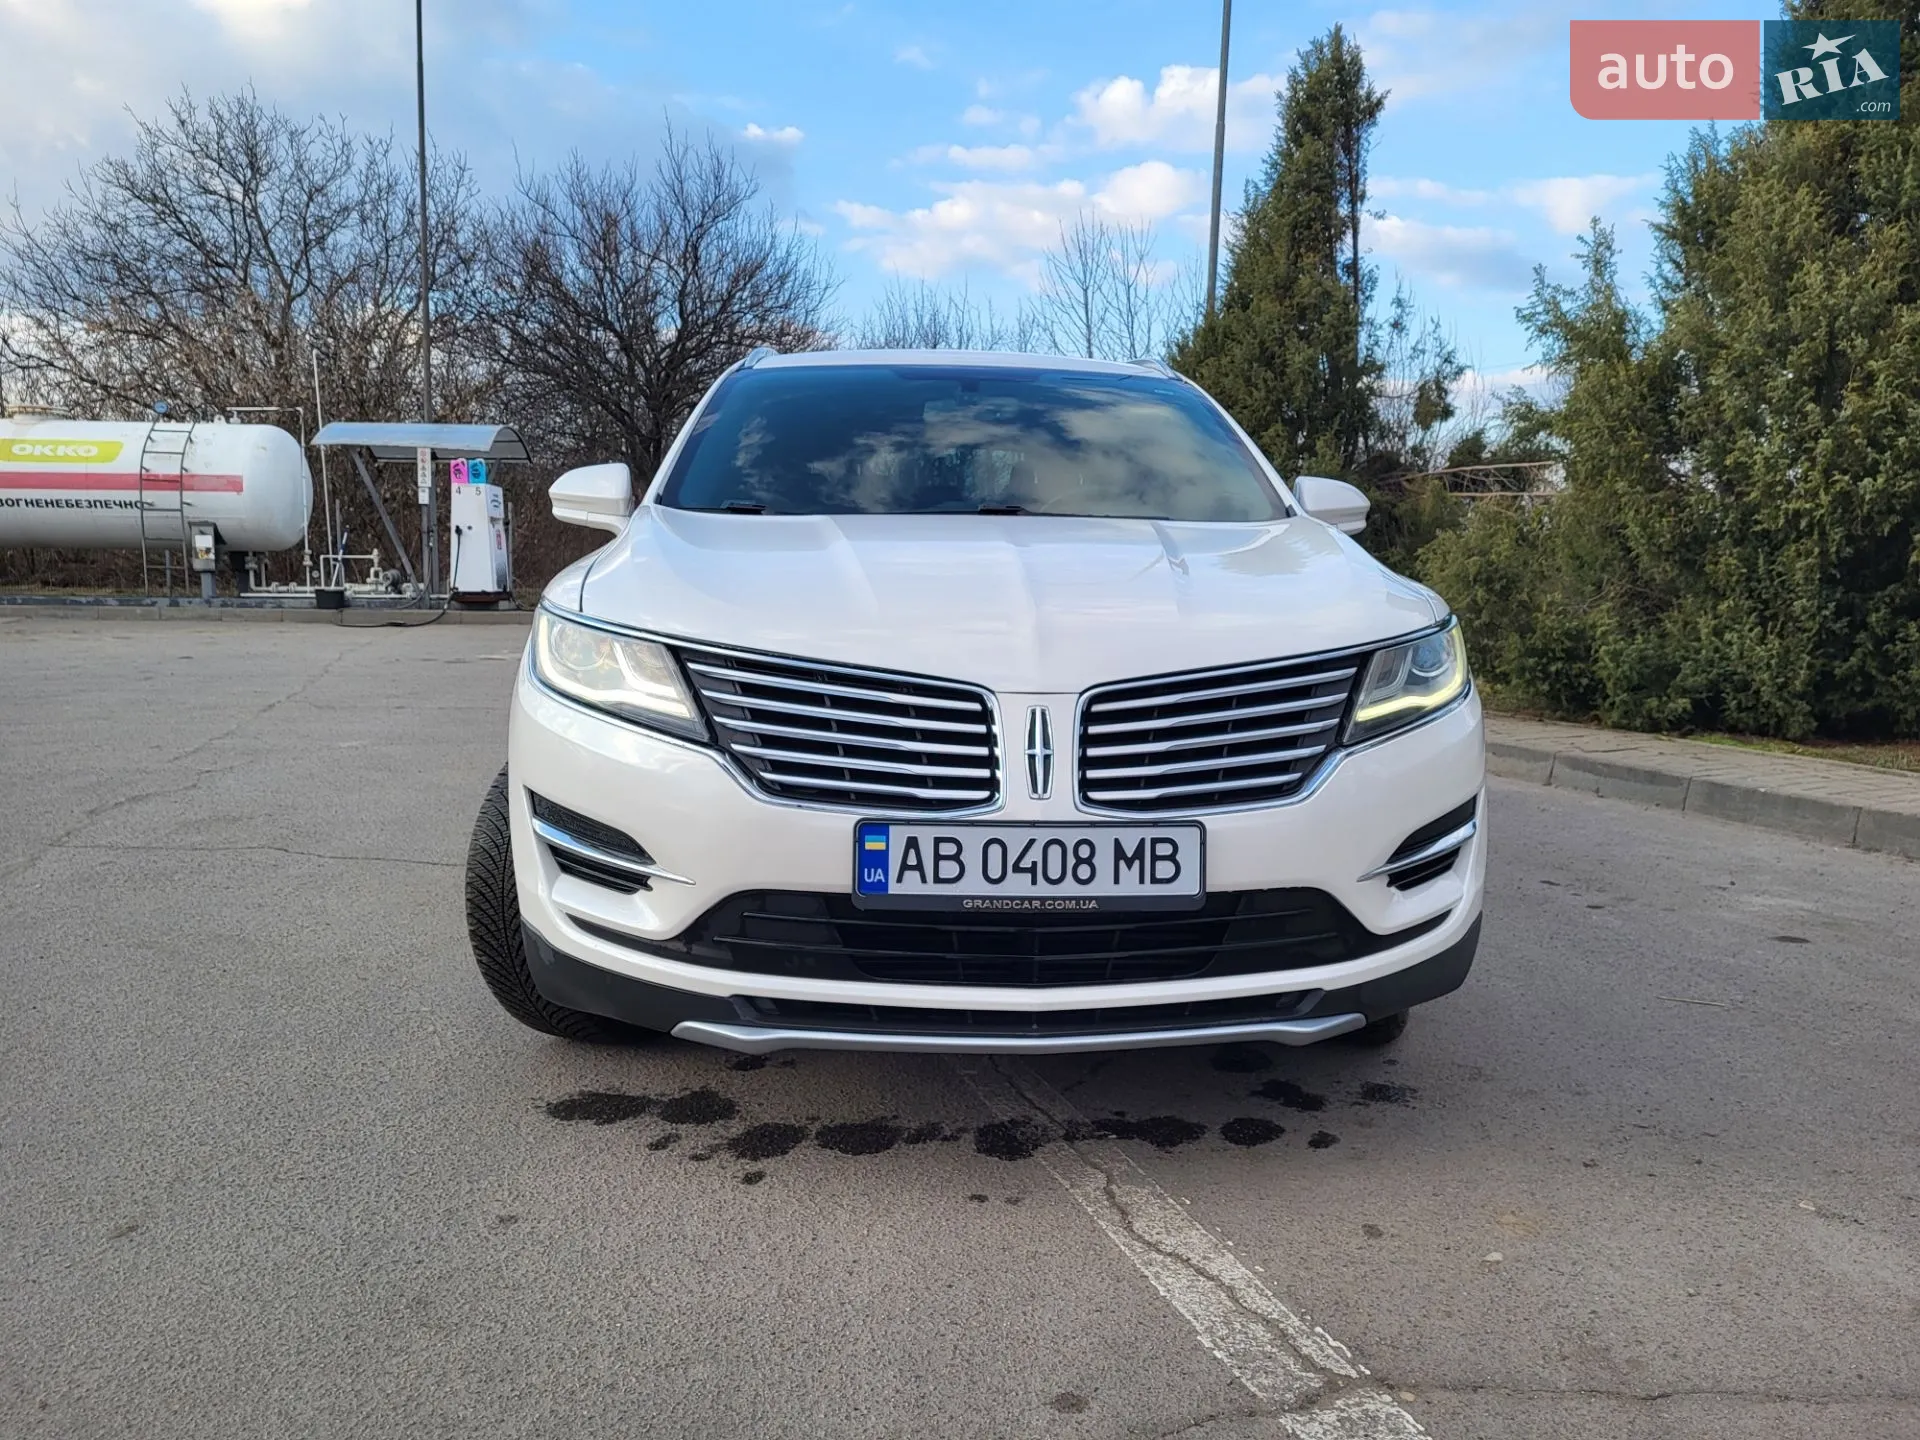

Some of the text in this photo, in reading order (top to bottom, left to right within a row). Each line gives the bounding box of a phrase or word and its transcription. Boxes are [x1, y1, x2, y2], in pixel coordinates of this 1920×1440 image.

[896, 836, 1181, 886] AB 0408 MB
[864, 868, 885, 883] UA
[963, 899, 1099, 910] GRANDCAR.COM.UA
